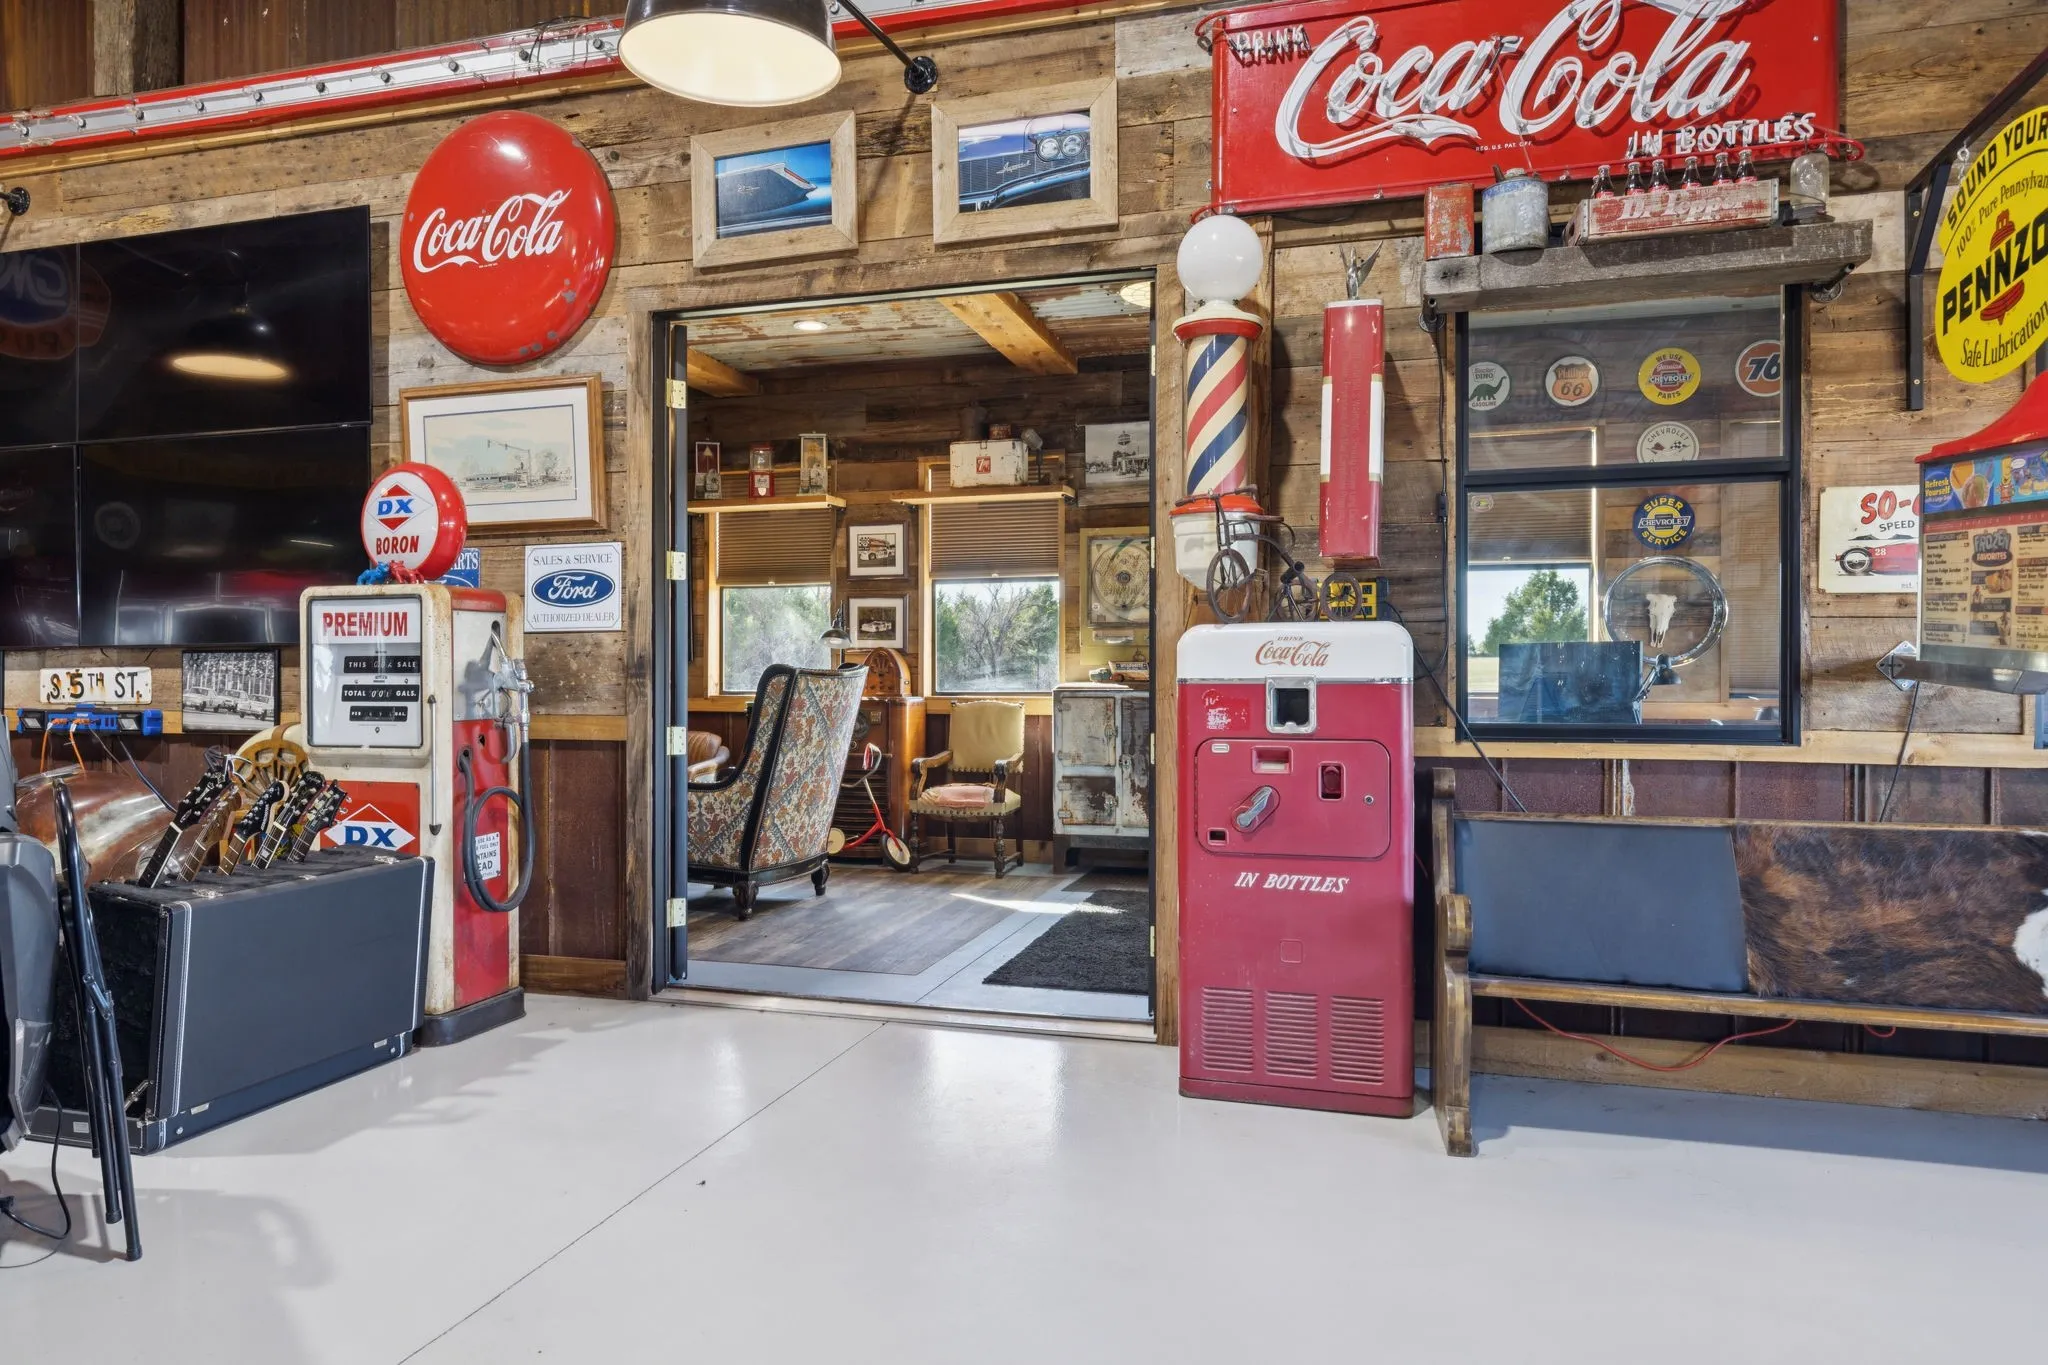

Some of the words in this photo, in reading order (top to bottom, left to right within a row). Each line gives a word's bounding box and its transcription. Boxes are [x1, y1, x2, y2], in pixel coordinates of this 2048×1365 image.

[1235, 23, 1308, 62] DRINK
[1275, 0, 1751, 158] Coca-Cola
[1626, 129, 1664, 159] IN
[1675, 112, 1816, 154] BOTTLES
[1947, 143, 1998, 230] SOUND
[2003, 111, 2048, 157] YOUR
[1979, 195, 1999, 225] Pure
[413, 187, 573, 273] Coca-Cola
[1961, 337, 1982, 368] Safe
[1983, 299, 2048, 367] Lubrication
[1655, 354, 1667, 362] WE
[1669, 353, 1683, 362] USE
[1744, 353, 1781, 383] 76
[1649, 373, 1692, 384] CHEVROLET
[1560, 382, 1585, 397] 66
[1657, 390, 1681, 400] PARTS
[1647, 427, 1689, 443] CHEVROLET
[1925, 478, 1949, 488] Refresh
[1925, 486, 1951, 497] Yourself
[377, 498, 415, 516] DX
[1643, 497, 1684, 512] SUPER
[1640, 518, 1688, 527] CHEVROLET
[1879, 520, 1916, 533] SPEED
[375, 535, 420, 555] BORON
[1641, 529, 1688, 546] SERVICE
[533, 555, 563, 566] SALES
[565, 556, 572, 565] &
[573, 553, 613, 565] SERVICE
[1874, 548, 1887, 556] 28
[547, 575, 598, 600] Ford
[322, 611, 408, 637] PREMIUM
[532, 613, 581, 623] AUTHORIZED
[582, 611, 615, 621] DEALER
[1255, 640, 1333, 667] Coca-Cola
[69, 671, 105, 699] 5TH
[114, 671, 143, 698] ST.
[344, 825, 397, 848] DX
[1234, 871, 1260, 888] IN
[1263, 873, 1350, 894] BOTTLES
